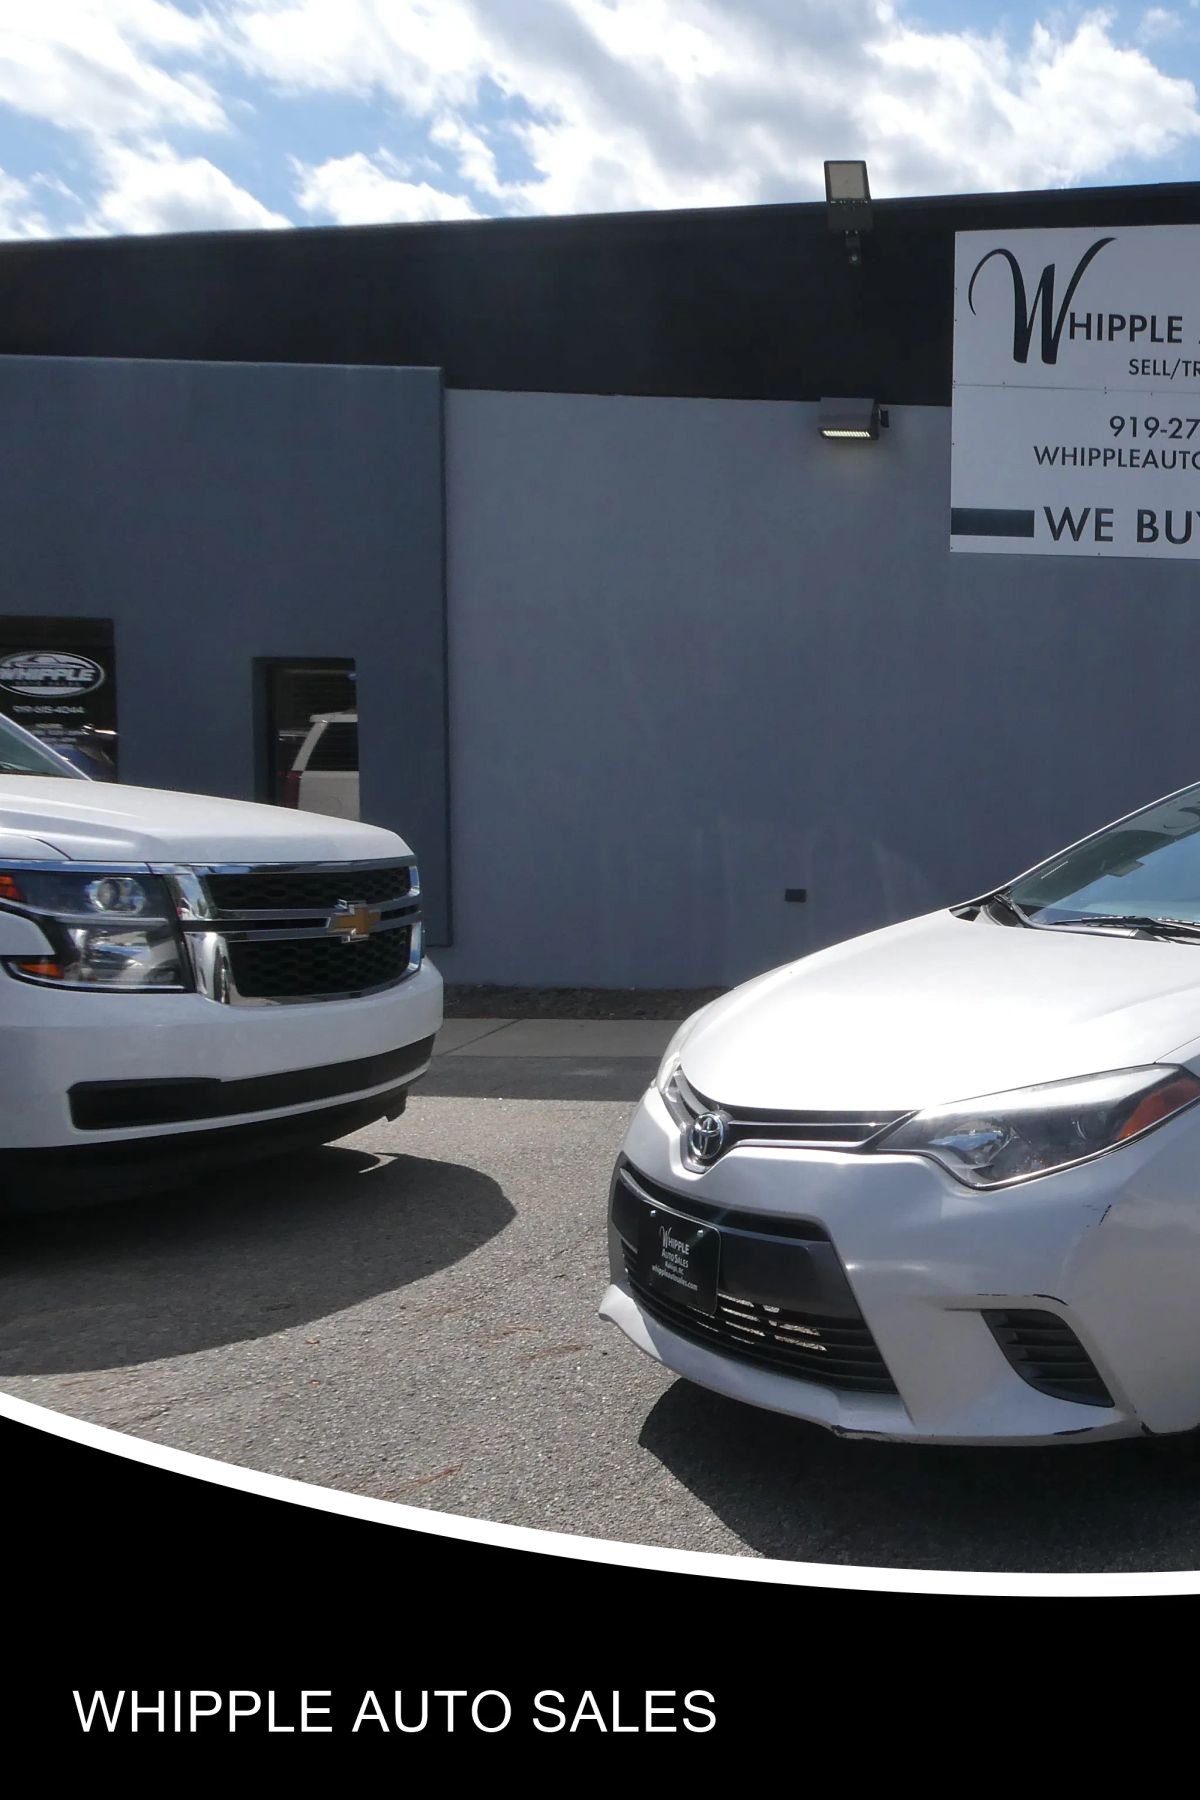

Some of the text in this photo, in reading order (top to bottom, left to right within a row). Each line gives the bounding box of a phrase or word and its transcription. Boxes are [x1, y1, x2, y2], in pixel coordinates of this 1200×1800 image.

[968, 237, 1183, 366] WHIPPLE
[1043, 506, 1115, 543] WE
[0, 667, 95, 681] WHIPPLE
[659, 1225, 690, 1255] WHIPPLE
[661, 1248, 689, 1269] AUTO SALES
